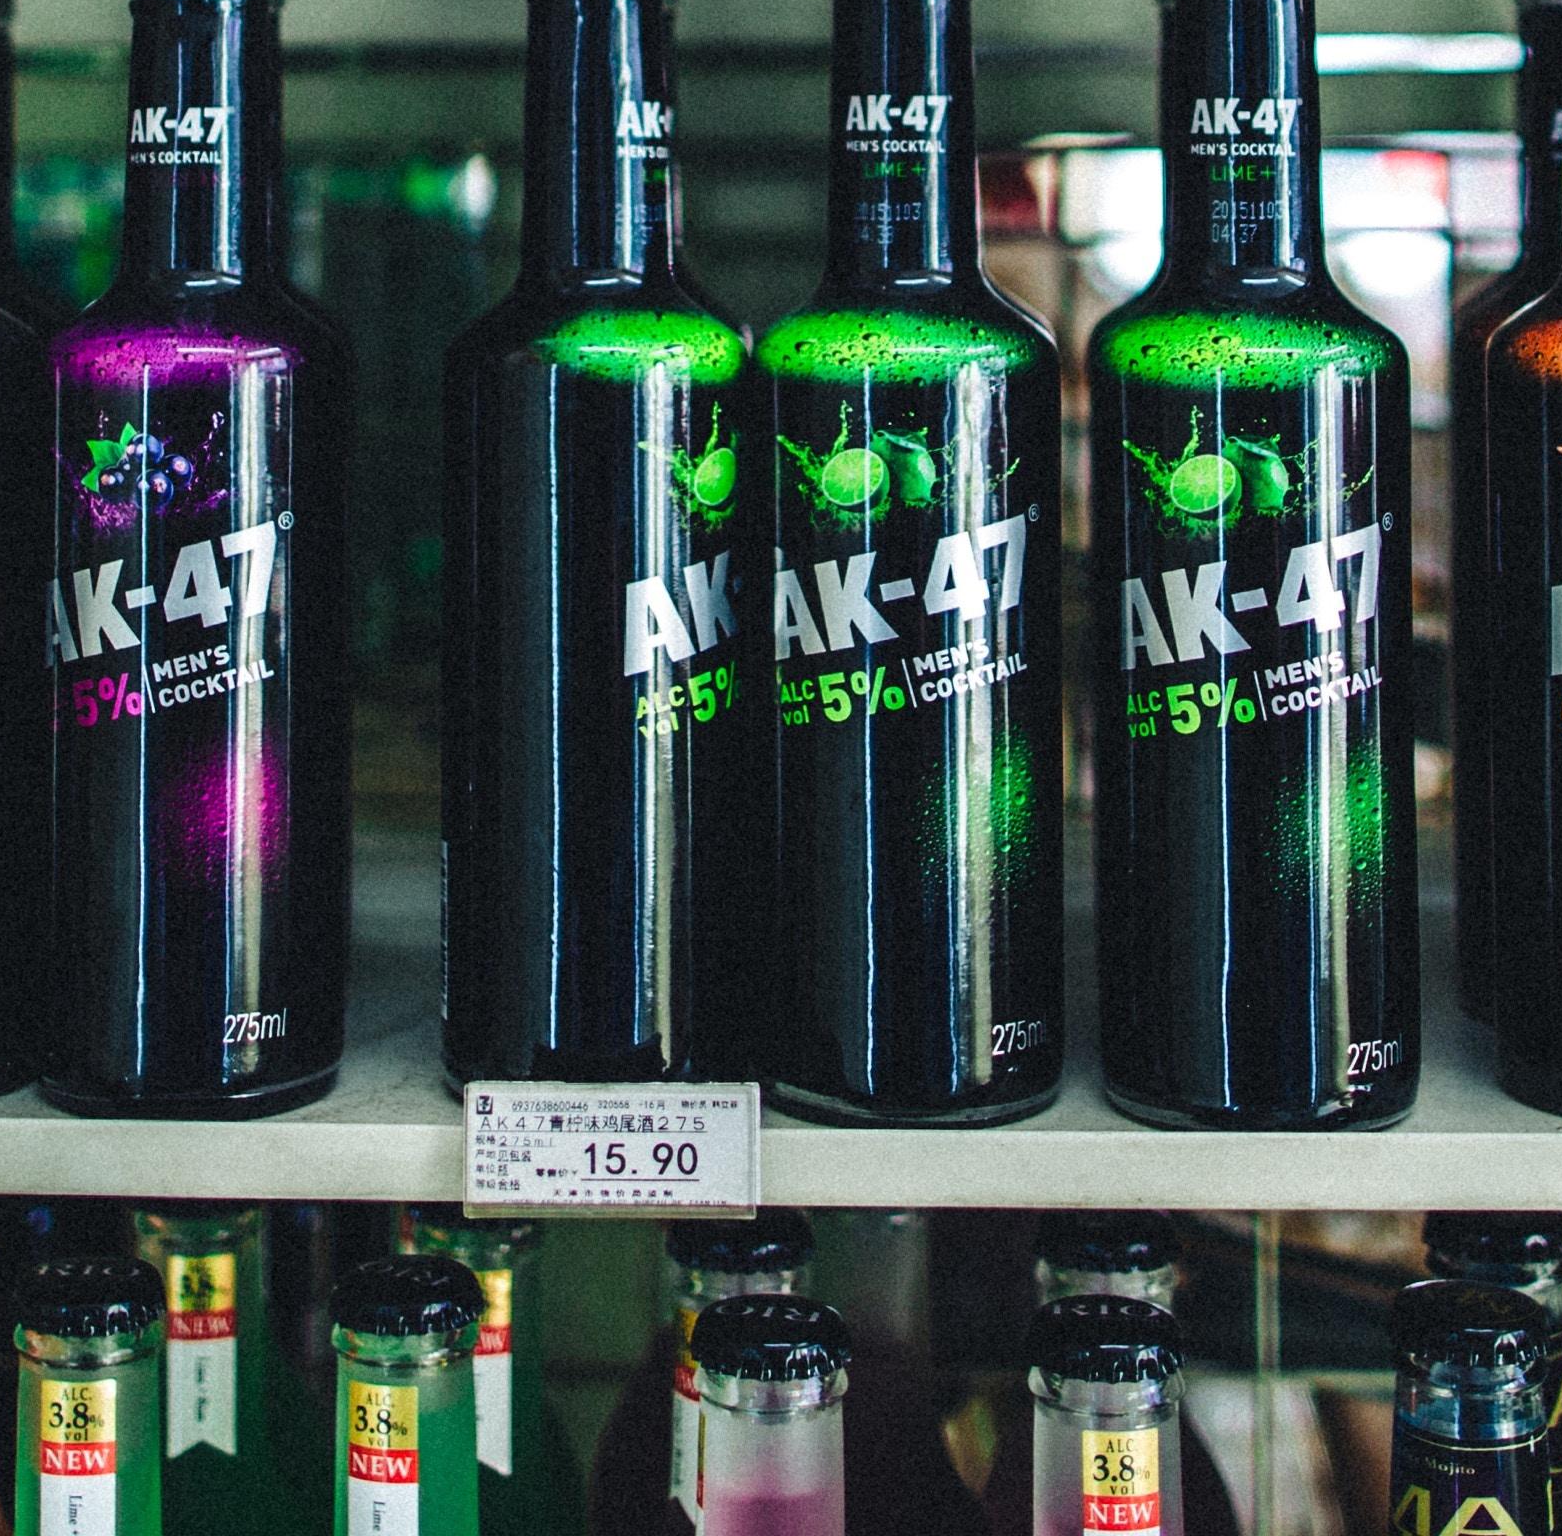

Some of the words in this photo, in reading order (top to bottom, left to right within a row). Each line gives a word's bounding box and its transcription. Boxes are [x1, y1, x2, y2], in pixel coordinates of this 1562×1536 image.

[130, 106, 228, 144] AK-47
[845, 93, 949, 133] AK-47
[1190, 97, 1298, 136] AK-47
[157, 150, 223, 164] COCKTAIL
[846, 139, 880, 152] MEN'S
[882, 139, 947, 153] COCKTAIL
[1190, 143, 1228, 156] MEN'S
[1231, 143, 1296, 157] COCKTAIL
[774, 514, 1028, 663] AK-47
[1120, 522, 1384, 672] AK-47
[152, 643, 231, 681] MEN'S
[912, 637, 991, 677] MEN'S
[1265, 650, 1346, 690] MEN'S
[158, 657, 275, 709] COCKTAIL
[780, 676, 816, 706] ALC
[820, 664, 906, 724] 5%
[920, 652, 1029, 704] COCKTAIL
[1271, 665, 1384, 718] COCKTAIL
[72, 670, 144, 728] 5%
[636, 682, 686, 718] ALC
[782, 703, 811, 727] vol
[1125, 689, 1164, 717] ALC
[1166, 677, 1257, 736] 5%
[639, 713, 680, 740] vol
[1128, 715, 1157, 740] vol
[222, 1007, 287, 1044] 275ml
[1346, 1032, 1403, 1076] 275ml
[480, 1115, 705, 1133] AK47青柠味鸡尾酒275
[511, 1101, 589, 1113] 6937638600446
[583, 1142, 699, 1176] 15.90
[60, 1386, 94, 1402] ALC.
[63, 1427, 89, 1443] vol
[45, 1447, 110, 1471] NEW
[351, 1453, 413, 1478] NEW
[1109, 1481, 1136, 1496] vol
[68, 1494, 82, 1528] Lime
[373, 1500, 386, 1533] Lime
[1088, 1500, 1157, 1526] NEW
